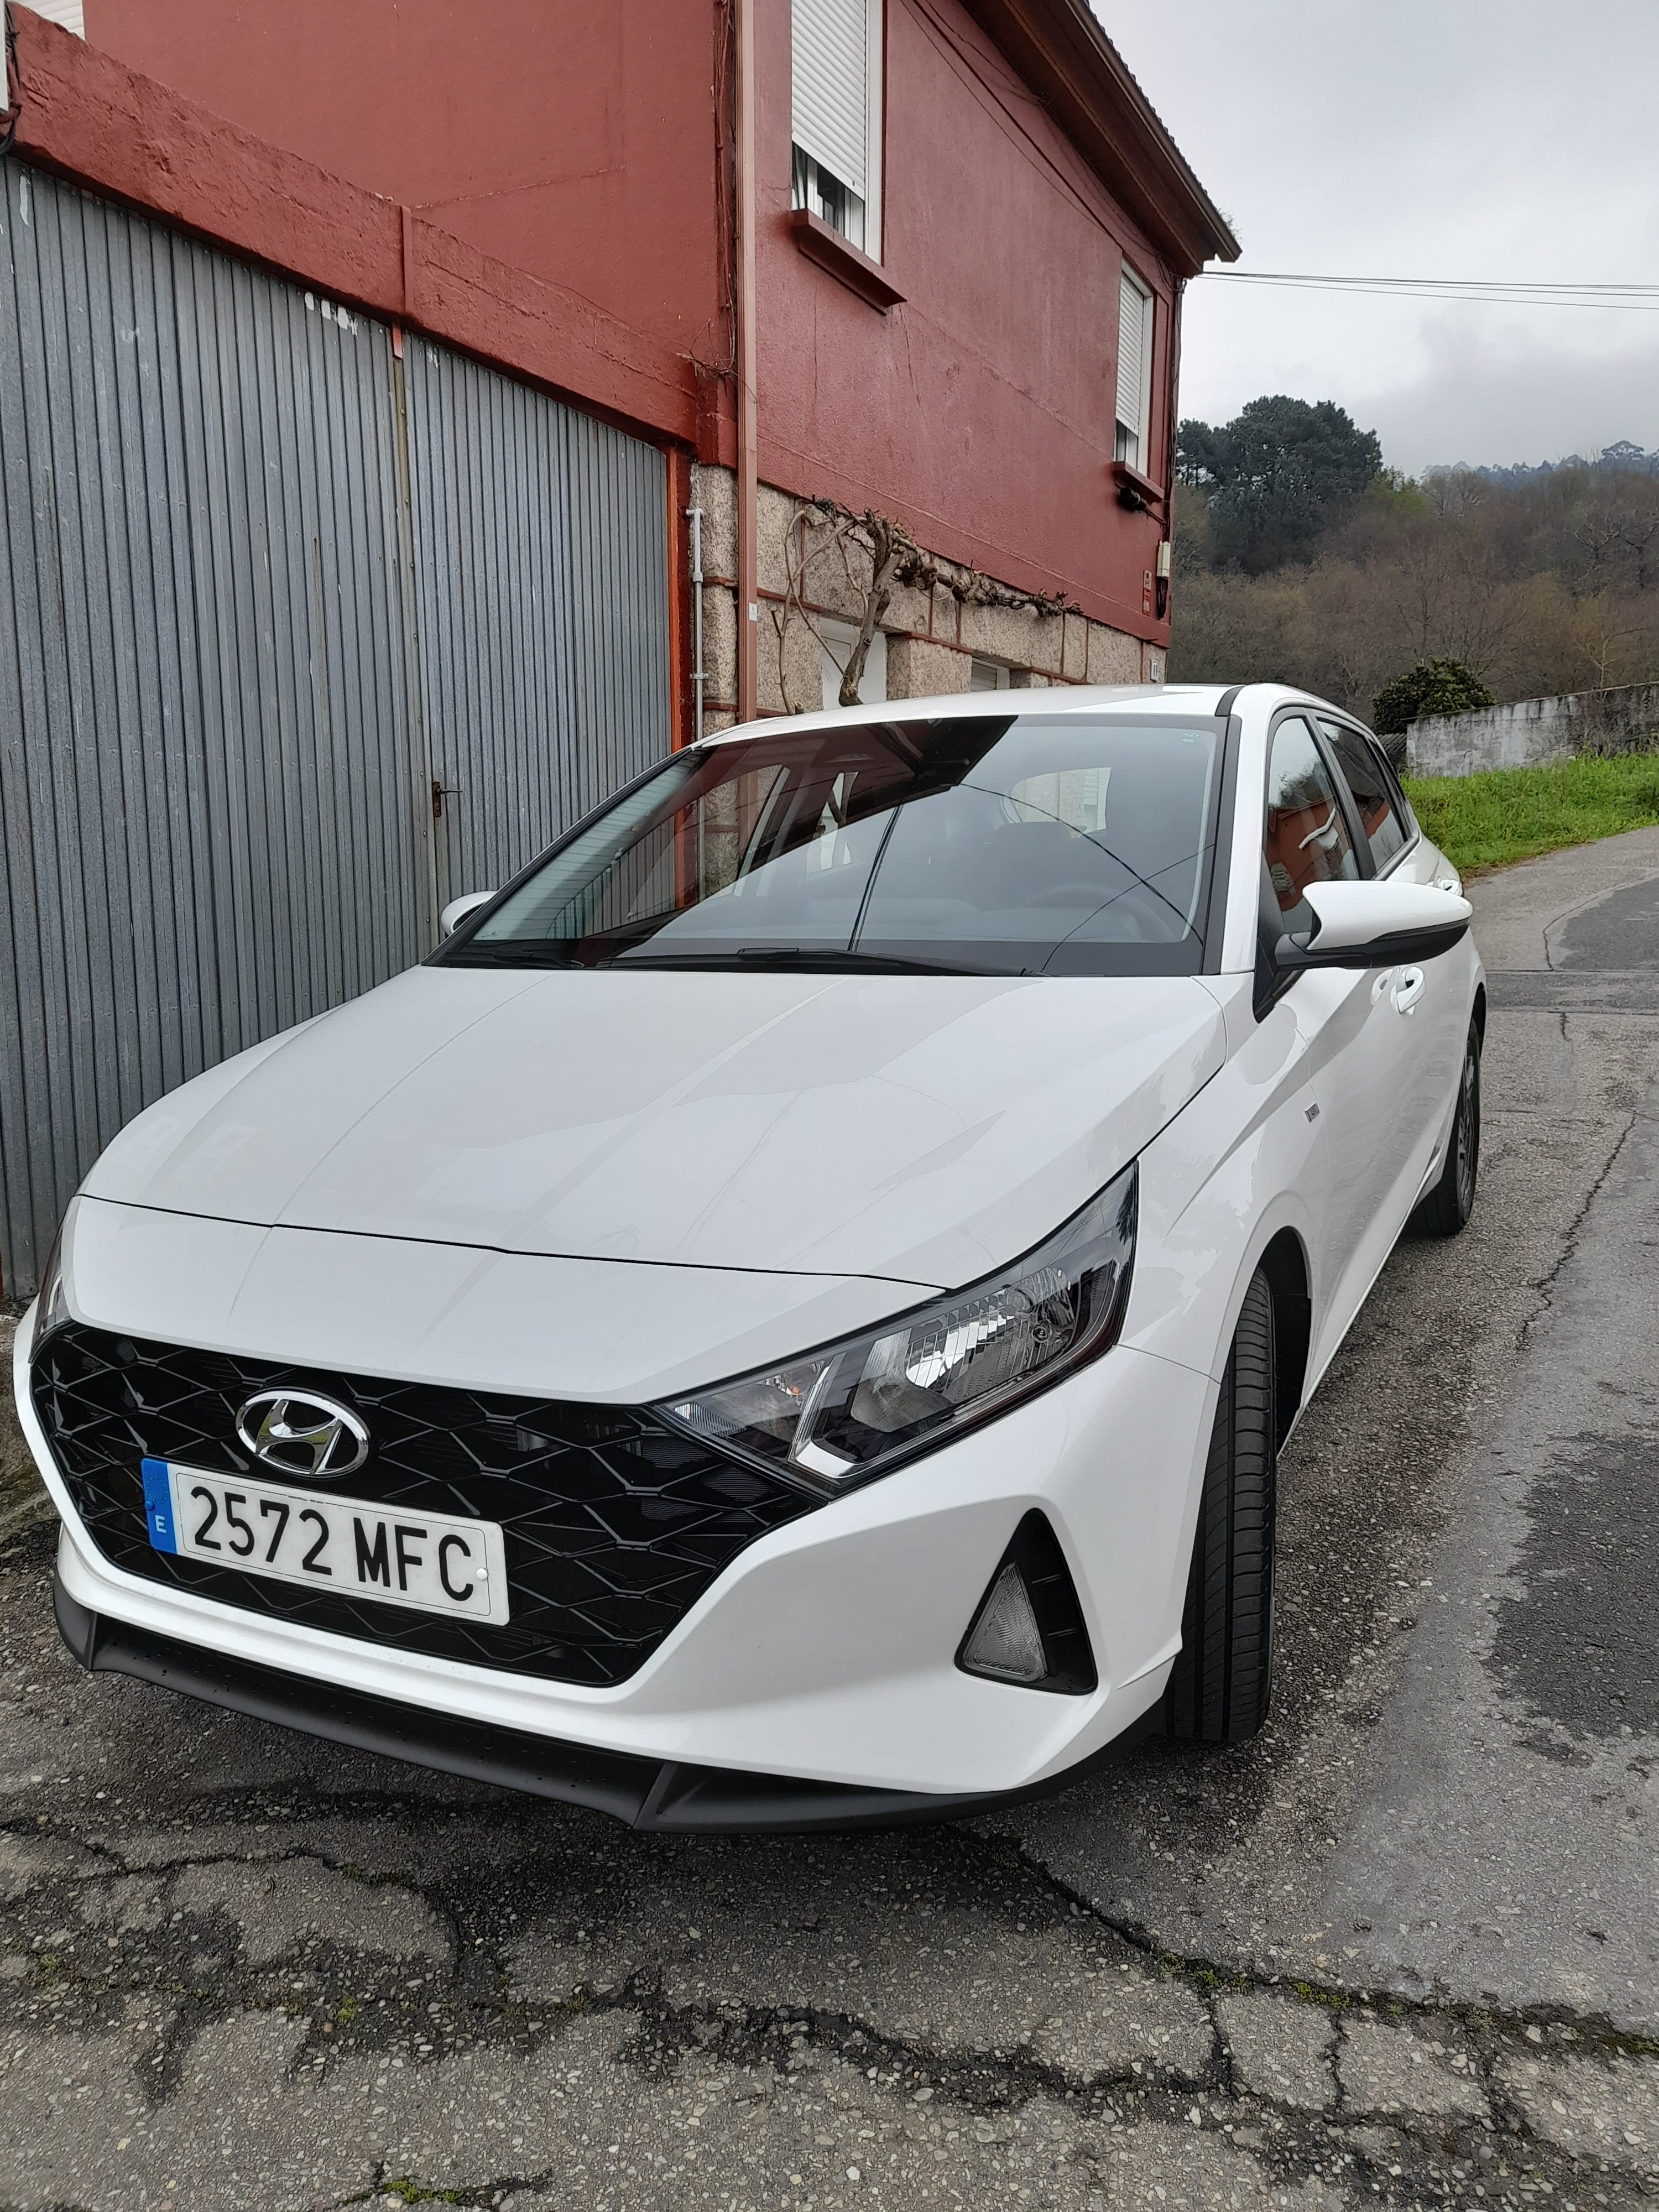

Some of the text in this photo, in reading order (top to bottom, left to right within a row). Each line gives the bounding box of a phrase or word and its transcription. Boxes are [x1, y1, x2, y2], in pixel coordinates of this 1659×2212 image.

[155, 1514, 167, 1533] E
[190, 1486, 474, 1601] 2572 MFC
